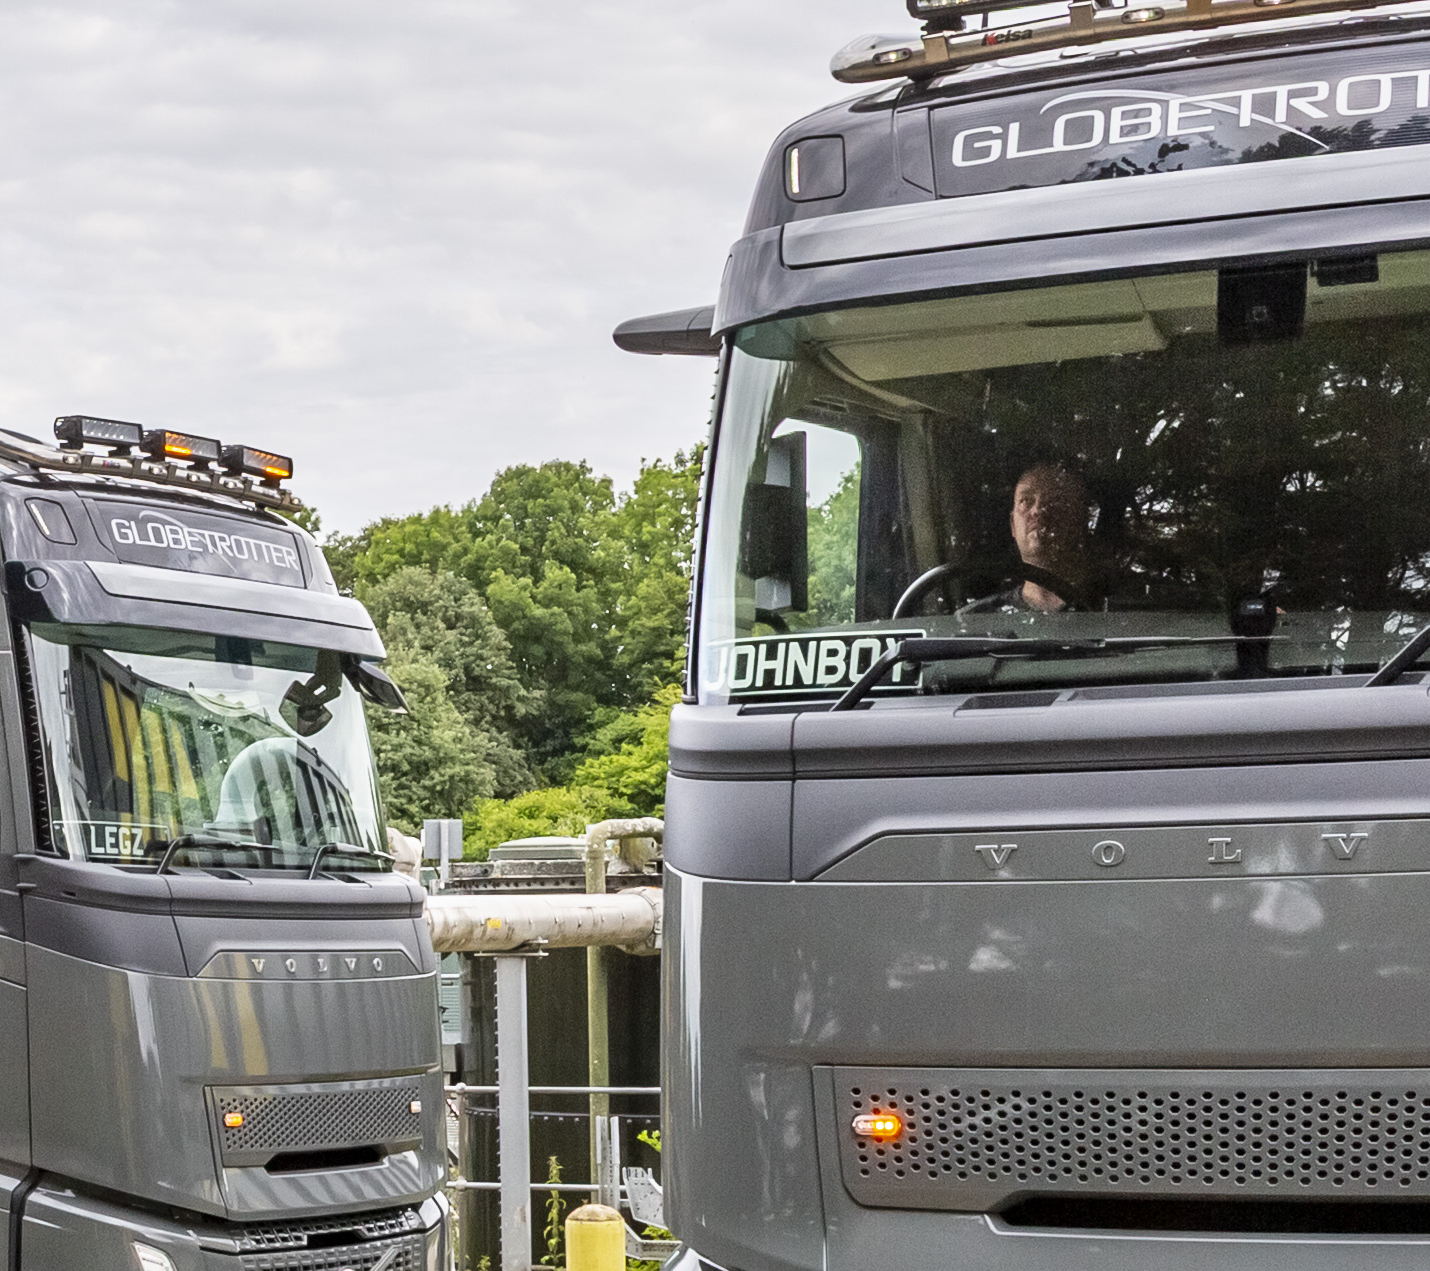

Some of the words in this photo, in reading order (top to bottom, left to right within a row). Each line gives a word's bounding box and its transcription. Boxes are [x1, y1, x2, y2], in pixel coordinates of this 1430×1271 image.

[110, 518, 299, 570] GLOBETROTTER
[90, 825, 145, 856] LEGZ
[251, 957, 383, 973] VOLVO
